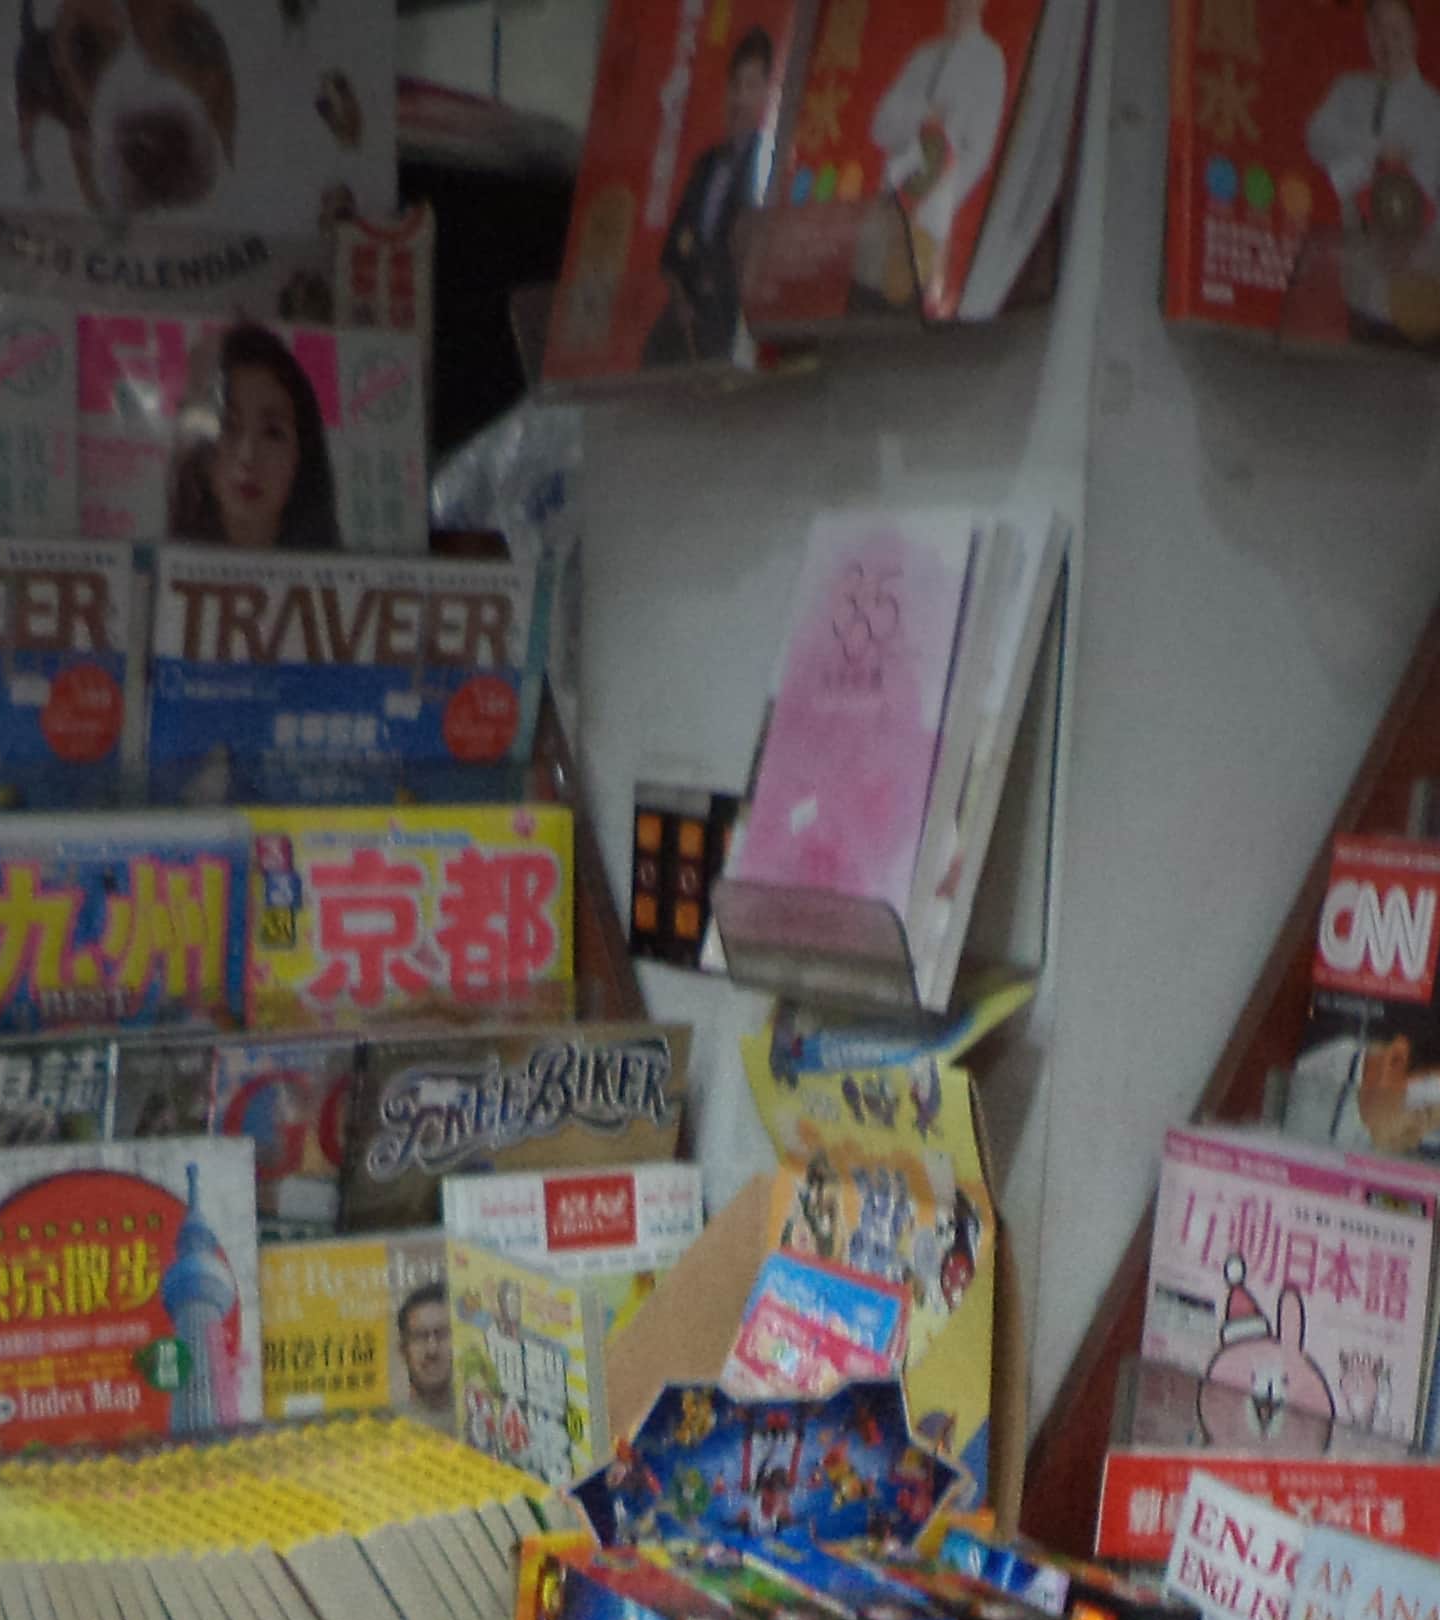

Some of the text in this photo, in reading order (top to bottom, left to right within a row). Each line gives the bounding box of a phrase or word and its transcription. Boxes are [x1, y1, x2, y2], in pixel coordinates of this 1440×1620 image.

[85, 235, 268, 290] CALENDAR
[310, 850, 558, 1010] 京都
[1318, 882, 1436, 980] CNN
[91, 1379, 142, 1416] Map
